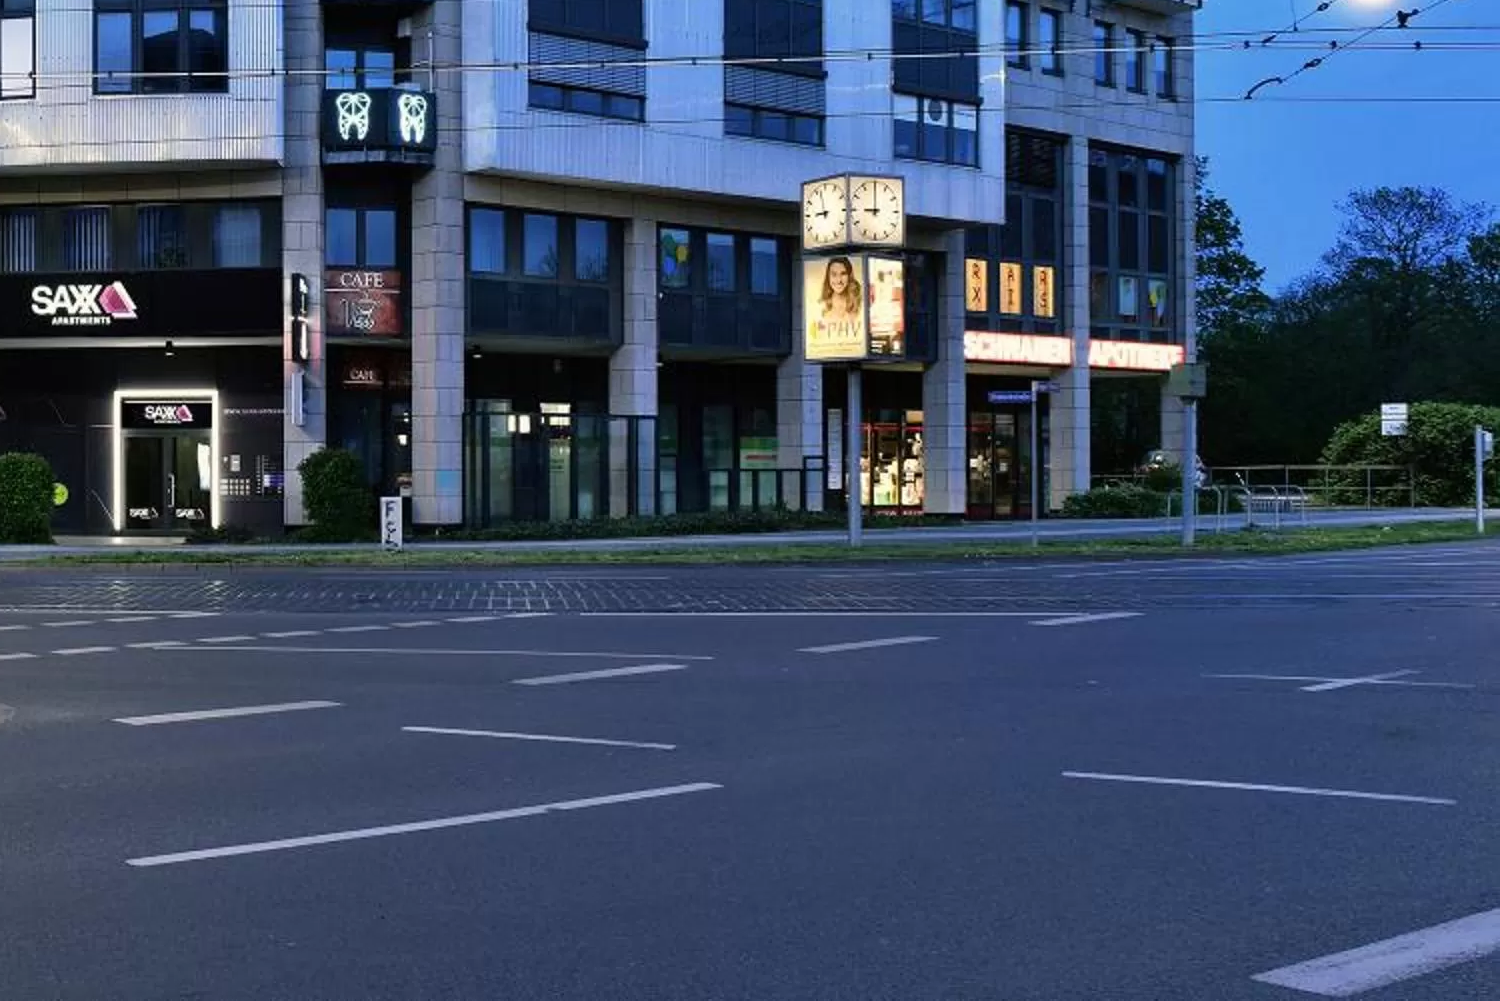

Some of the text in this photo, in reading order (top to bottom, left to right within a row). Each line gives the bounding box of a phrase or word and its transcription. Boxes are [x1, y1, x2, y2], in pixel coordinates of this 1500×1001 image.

[340, 272, 385, 288] CAFE
[31, 284, 102, 316] SAXX
[144, 405, 178, 420] SAXX
